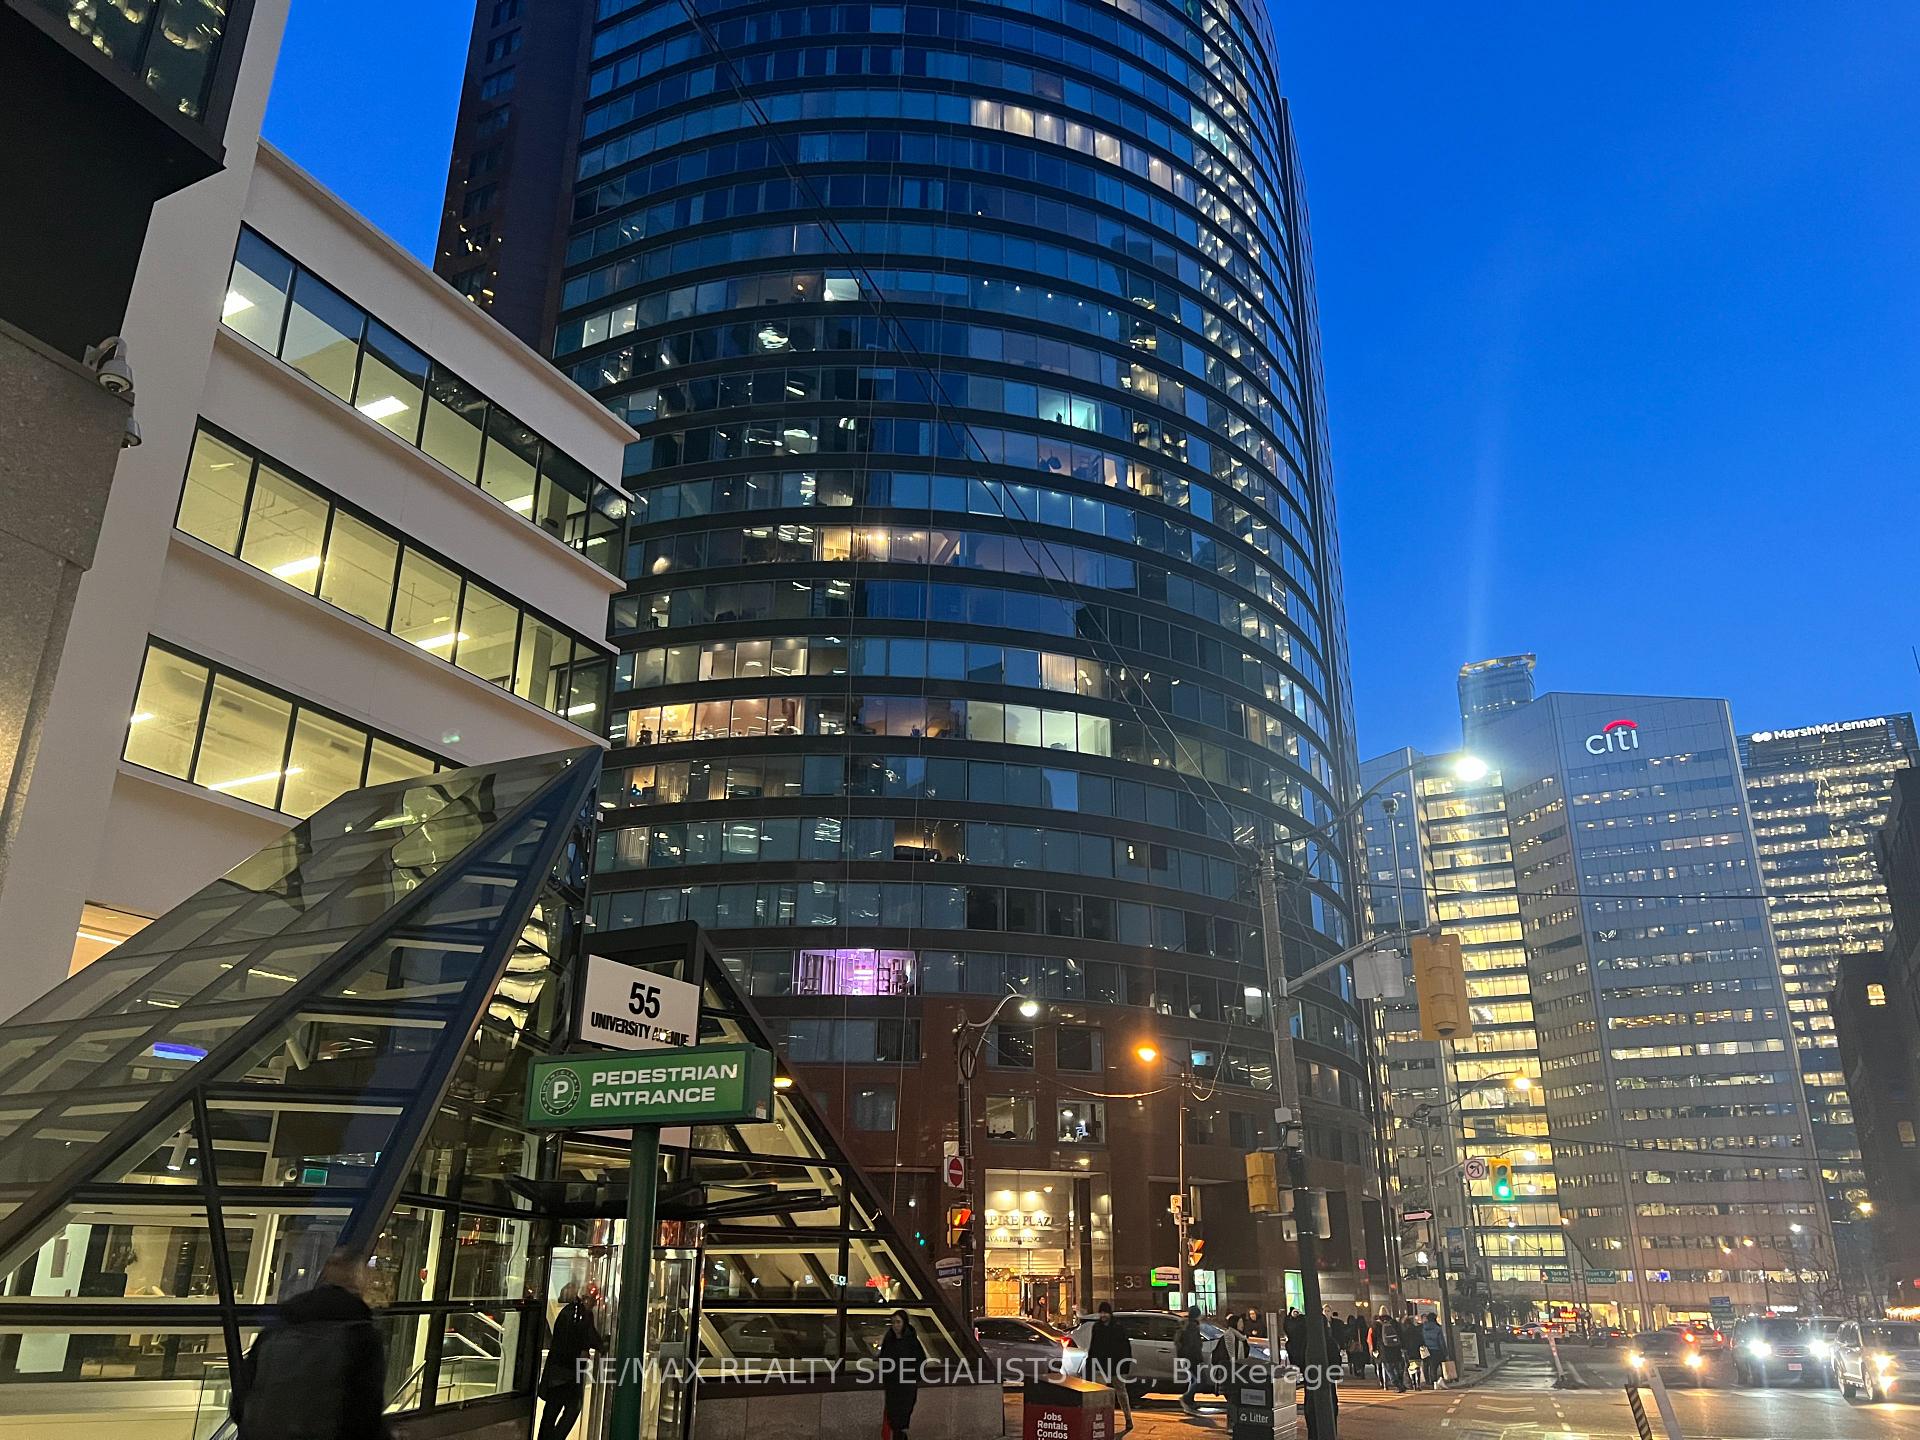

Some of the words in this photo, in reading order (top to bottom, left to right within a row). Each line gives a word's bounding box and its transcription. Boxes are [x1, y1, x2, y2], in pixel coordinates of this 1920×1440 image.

[1773, 717, 1887, 740] MarshMcLennan
[1585, 726, 1639, 755] citi
[628, 981, 661, 1019] 55
[591, 1011, 651, 1040] UNIVERSITY
[591, 1063, 738, 1087] PEDESTRIAN
[553, 1081, 569, 1100] P
[590, 1086, 716, 1108] ENTRANCE
[1037, 1420, 1068, 1431] Rentals
[1043, 1412, 1062, 1422] Jobs
[1250, 1412, 1268, 1423] Litter
[1037, 1429, 1068, 1440] Condos
